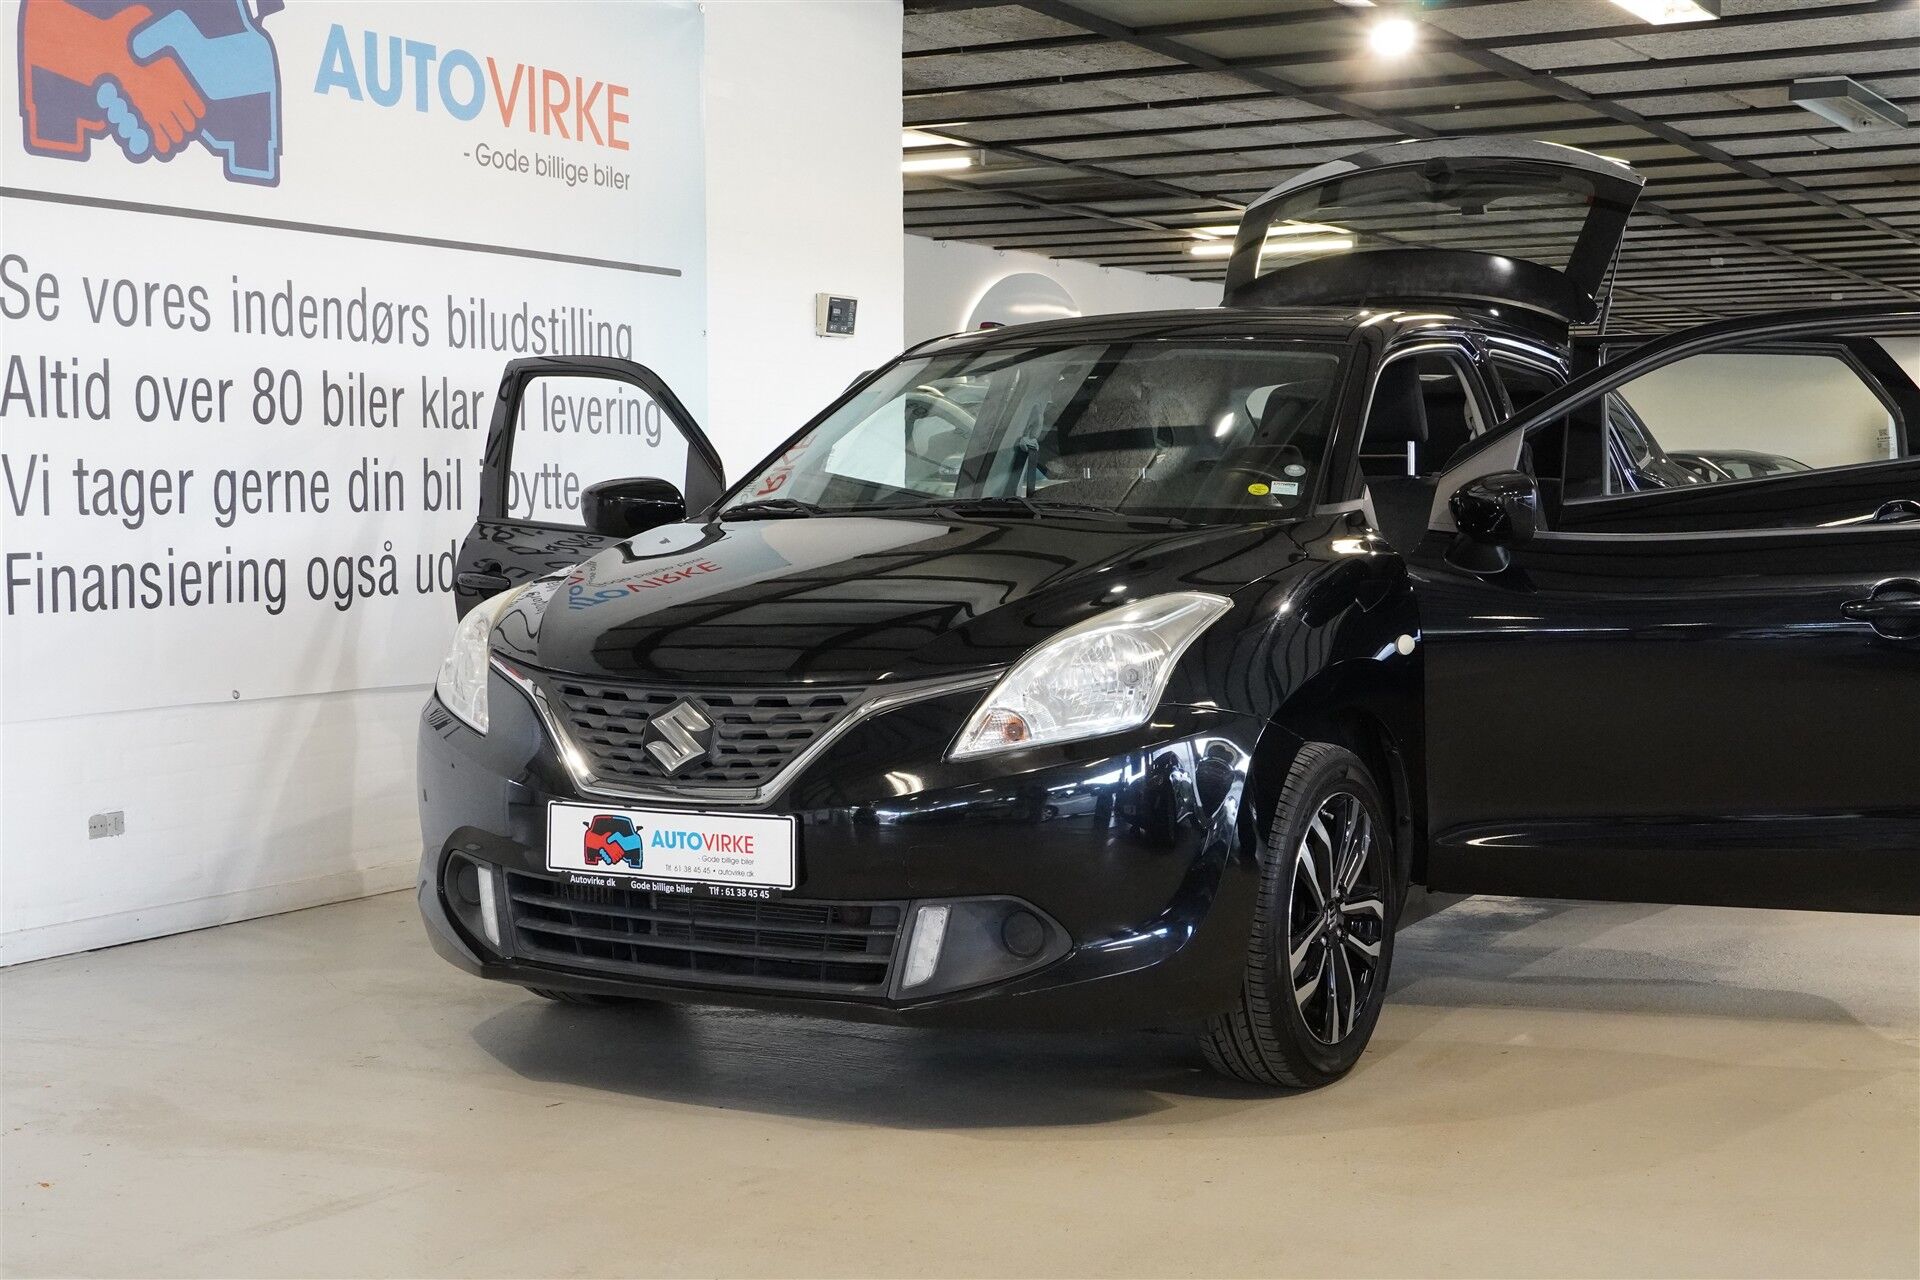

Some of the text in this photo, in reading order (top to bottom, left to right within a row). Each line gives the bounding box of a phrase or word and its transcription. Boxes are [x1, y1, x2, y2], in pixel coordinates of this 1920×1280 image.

[314, 23, 630, 151] AUTOVIRKE
[475, 142, 530, 173] Gode
[535, 152, 589, 187] billige
[594, 163, 630, 190] biler
[0, 253, 632, 360] Se vores indendørs biludstilling
[0, 354, 111, 421] Altid
[135, 374, 234, 424] over
[252, 366, 303, 426] 80
[322, 369, 405, 429] biler
[421, 375, 485, 430] klar
[542, 381, 662, 448] levering
[2, 453, 50, 517] Vi
[72, 458, 194, 531] tager
[213, 469, 330, 529] gerne
[348, 456, 405, 514] din
[423, 457, 462, 512] bil
[6, 545, 287, 616] Finansiering
[306, 539, 400, 612] også
[651, 830, 754, 854] AUTOVIRKE
[701, 855, 720, 863] Gode
[721, 857, 740, 865] billige
[570, 874, 605, 886] Autovirke
[630, 880, 694, 893] Gode billige biler
[703, 867, 711, 875] 45
[709, 886, 720, 895] Tlf
[725, 887, 735, 897] 61
[737, 888, 747, 897] 38
[748, 889, 758, 898] 45
[759, 890, 770, 899] 45
